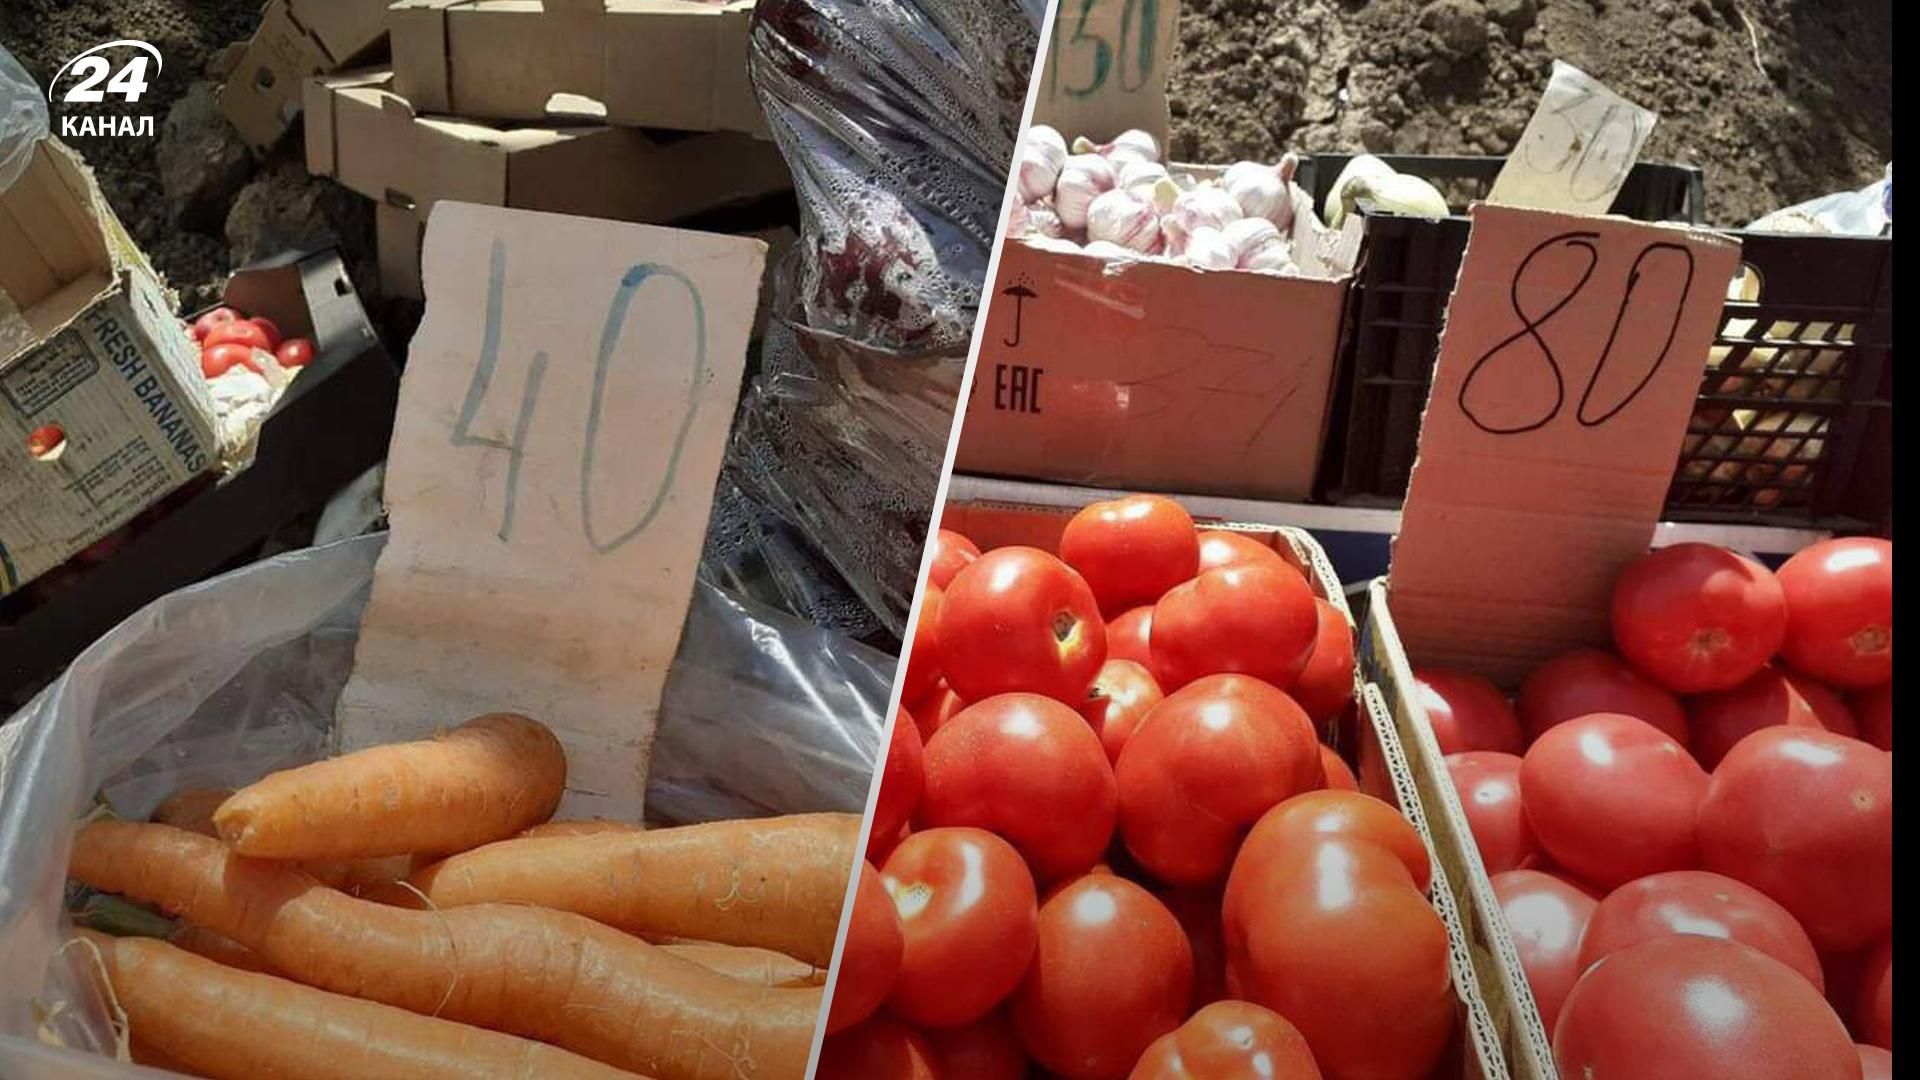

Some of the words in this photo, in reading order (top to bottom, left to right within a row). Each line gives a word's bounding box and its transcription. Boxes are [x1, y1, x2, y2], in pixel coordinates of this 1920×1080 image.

[1049, 0, 1159, 102] 150
[85, 308, 146, 381] FRESH
[134, 375, 207, 473] BANANAS
[450, 238, 707, 555] 40
[994, 364, 1044, 414] EAC
[1458, 231, 1694, 434] 80
